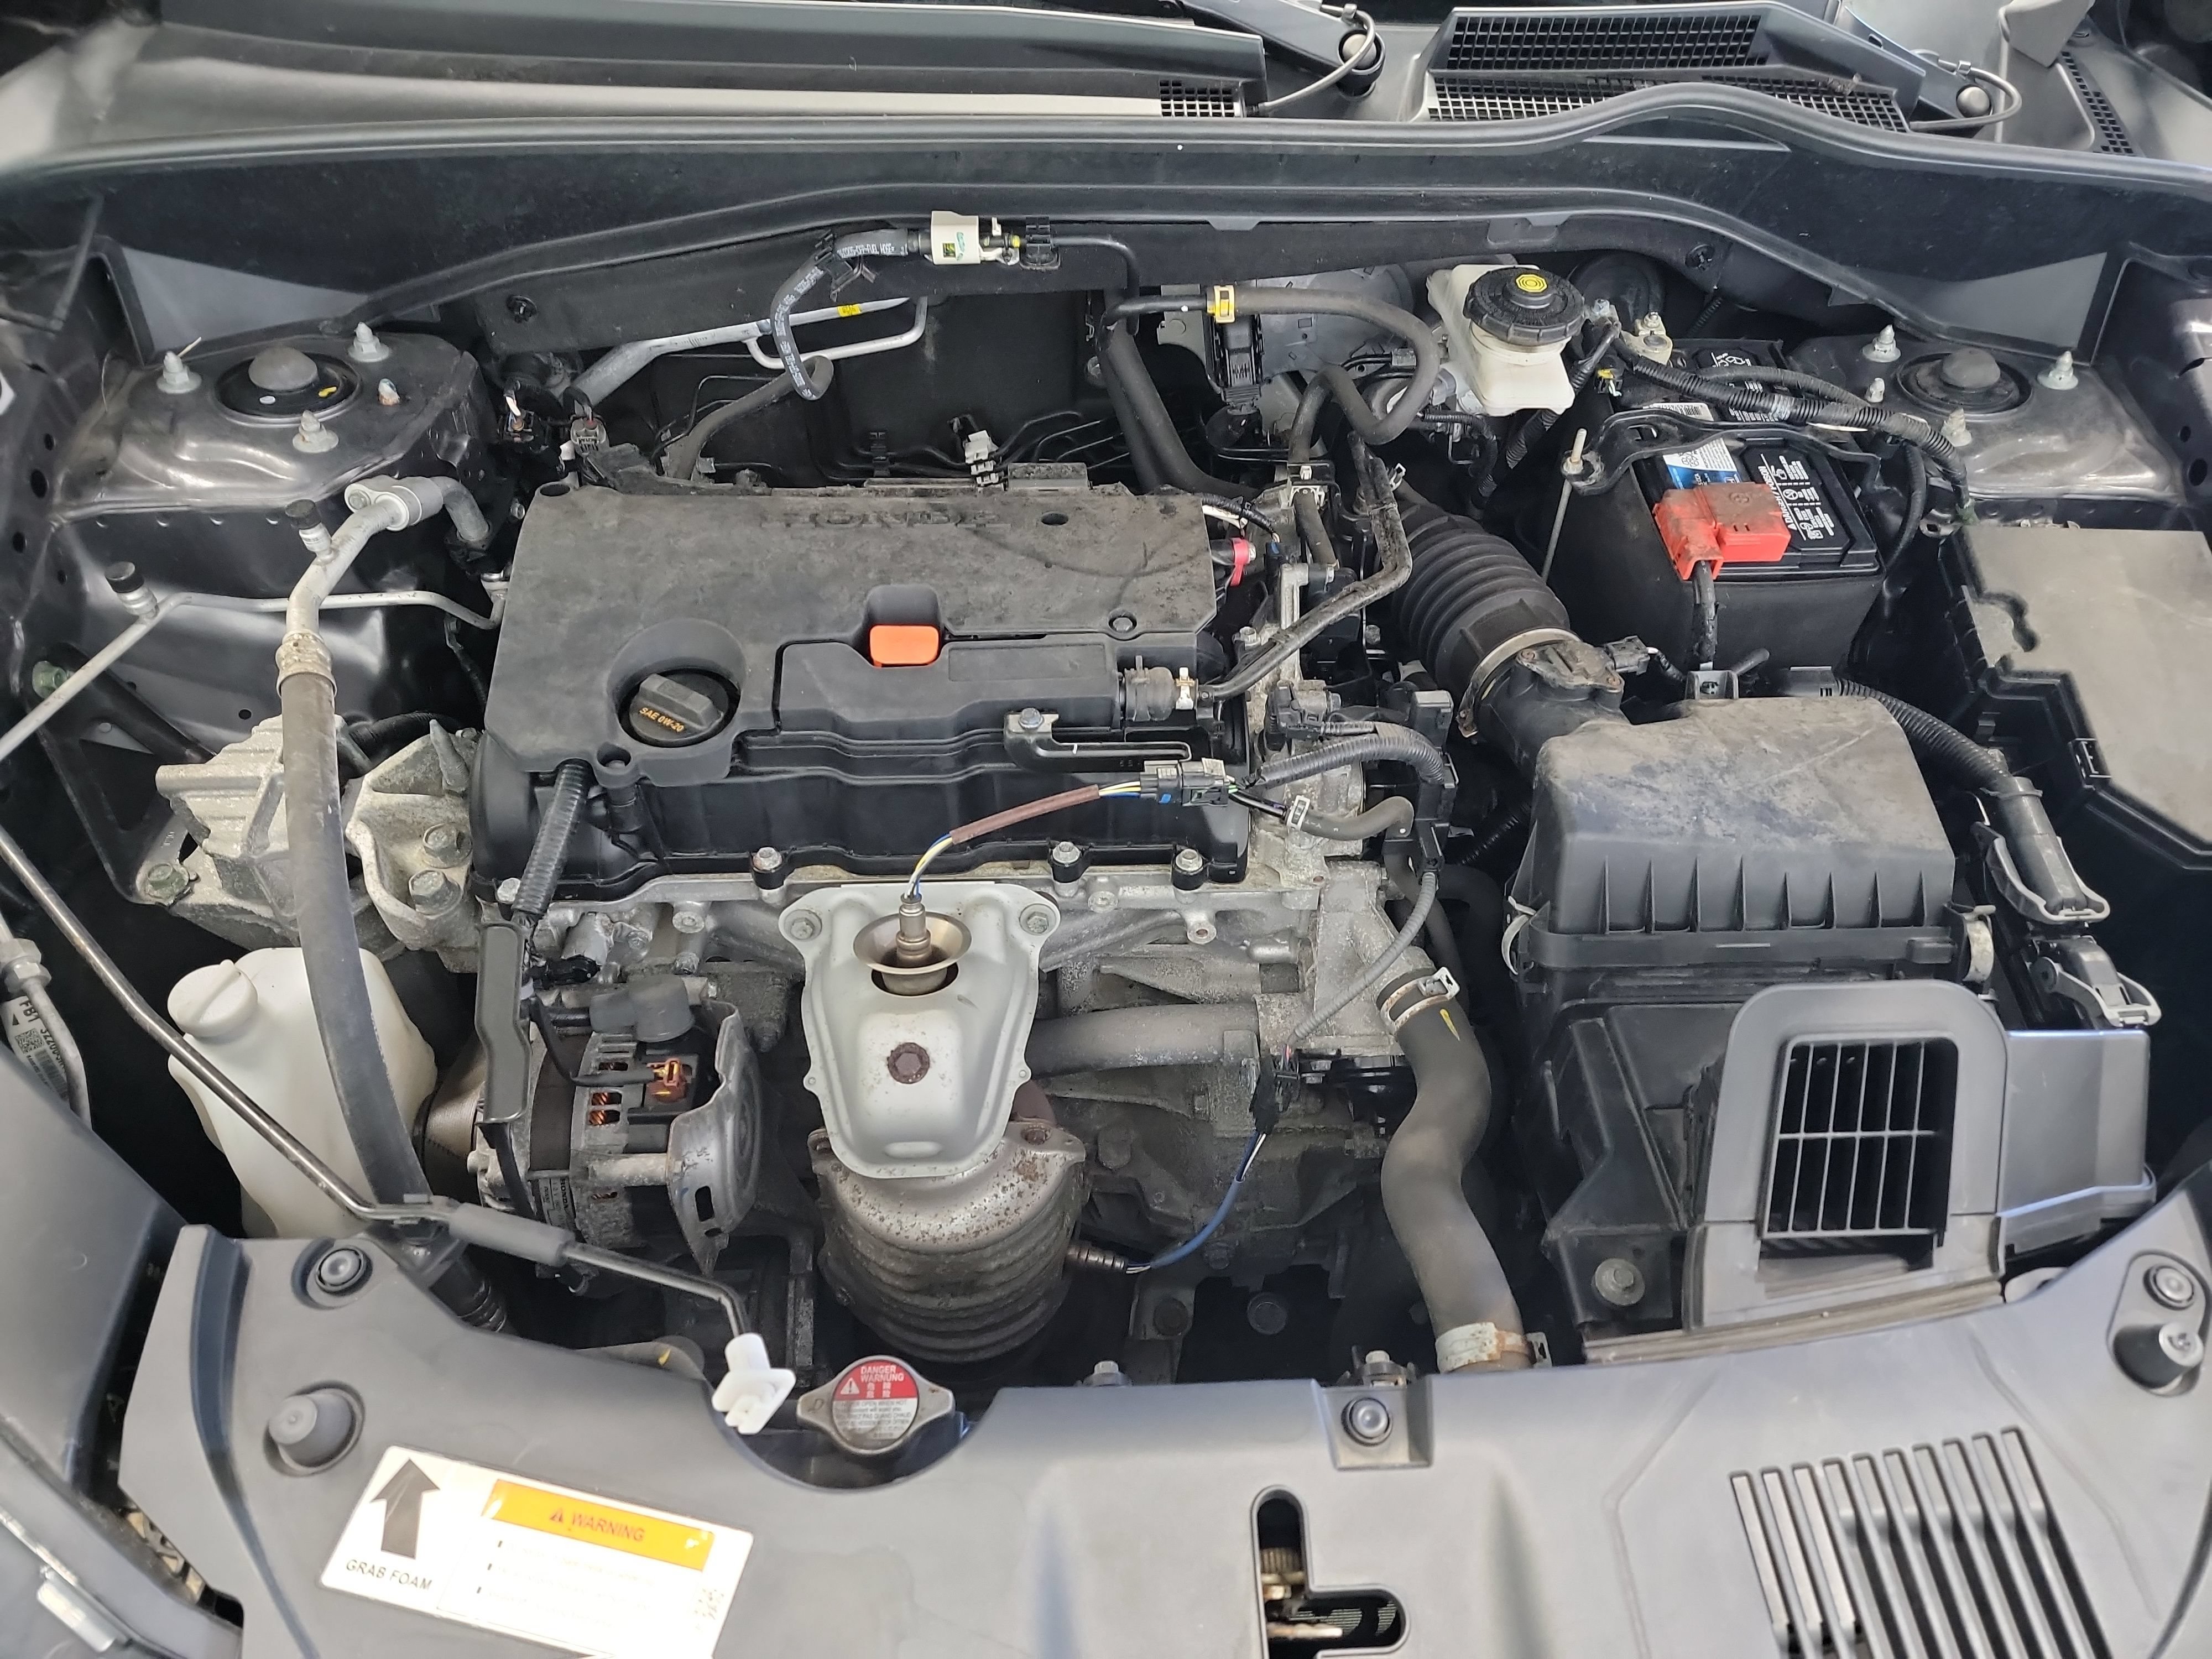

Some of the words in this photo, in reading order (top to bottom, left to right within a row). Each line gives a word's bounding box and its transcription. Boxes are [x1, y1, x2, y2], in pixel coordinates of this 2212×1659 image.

[639, 707, 660, 720] SAE
[658, 716, 685, 733] 0W-20
[860, 1365, 897, 1374] DANGER
[860, 1373, 905, 1383] WARNUNG
[572, 1511, 645, 1542] WARNING
[346, 1559, 386, 1578] GRAB
[390, 1570, 432, 1590] FOAM
